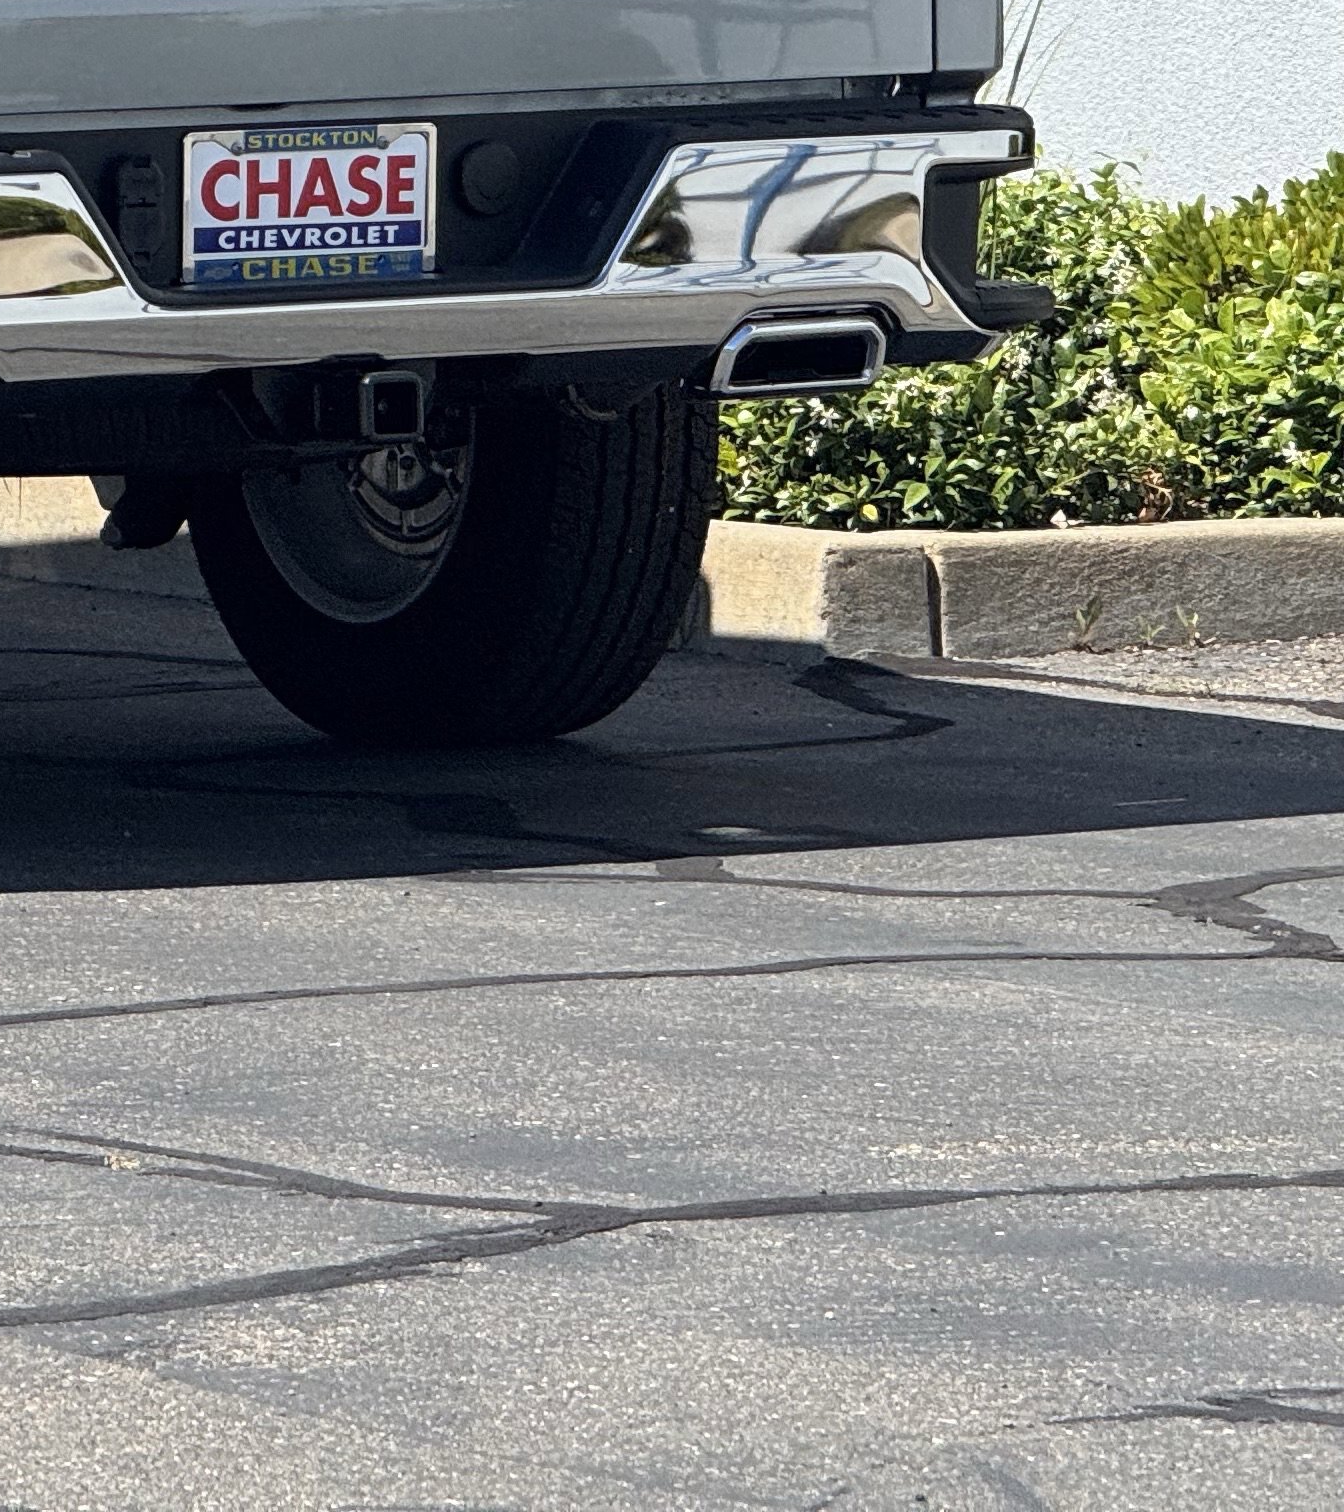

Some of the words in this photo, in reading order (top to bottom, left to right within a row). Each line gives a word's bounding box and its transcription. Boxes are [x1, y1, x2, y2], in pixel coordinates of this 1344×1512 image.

[247, 129, 376, 150] STOCKTON
[200, 154, 417, 222] CHASE
[217, 224, 400, 250] CHEVROLET
[241, 253, 379, 281] CHASE
